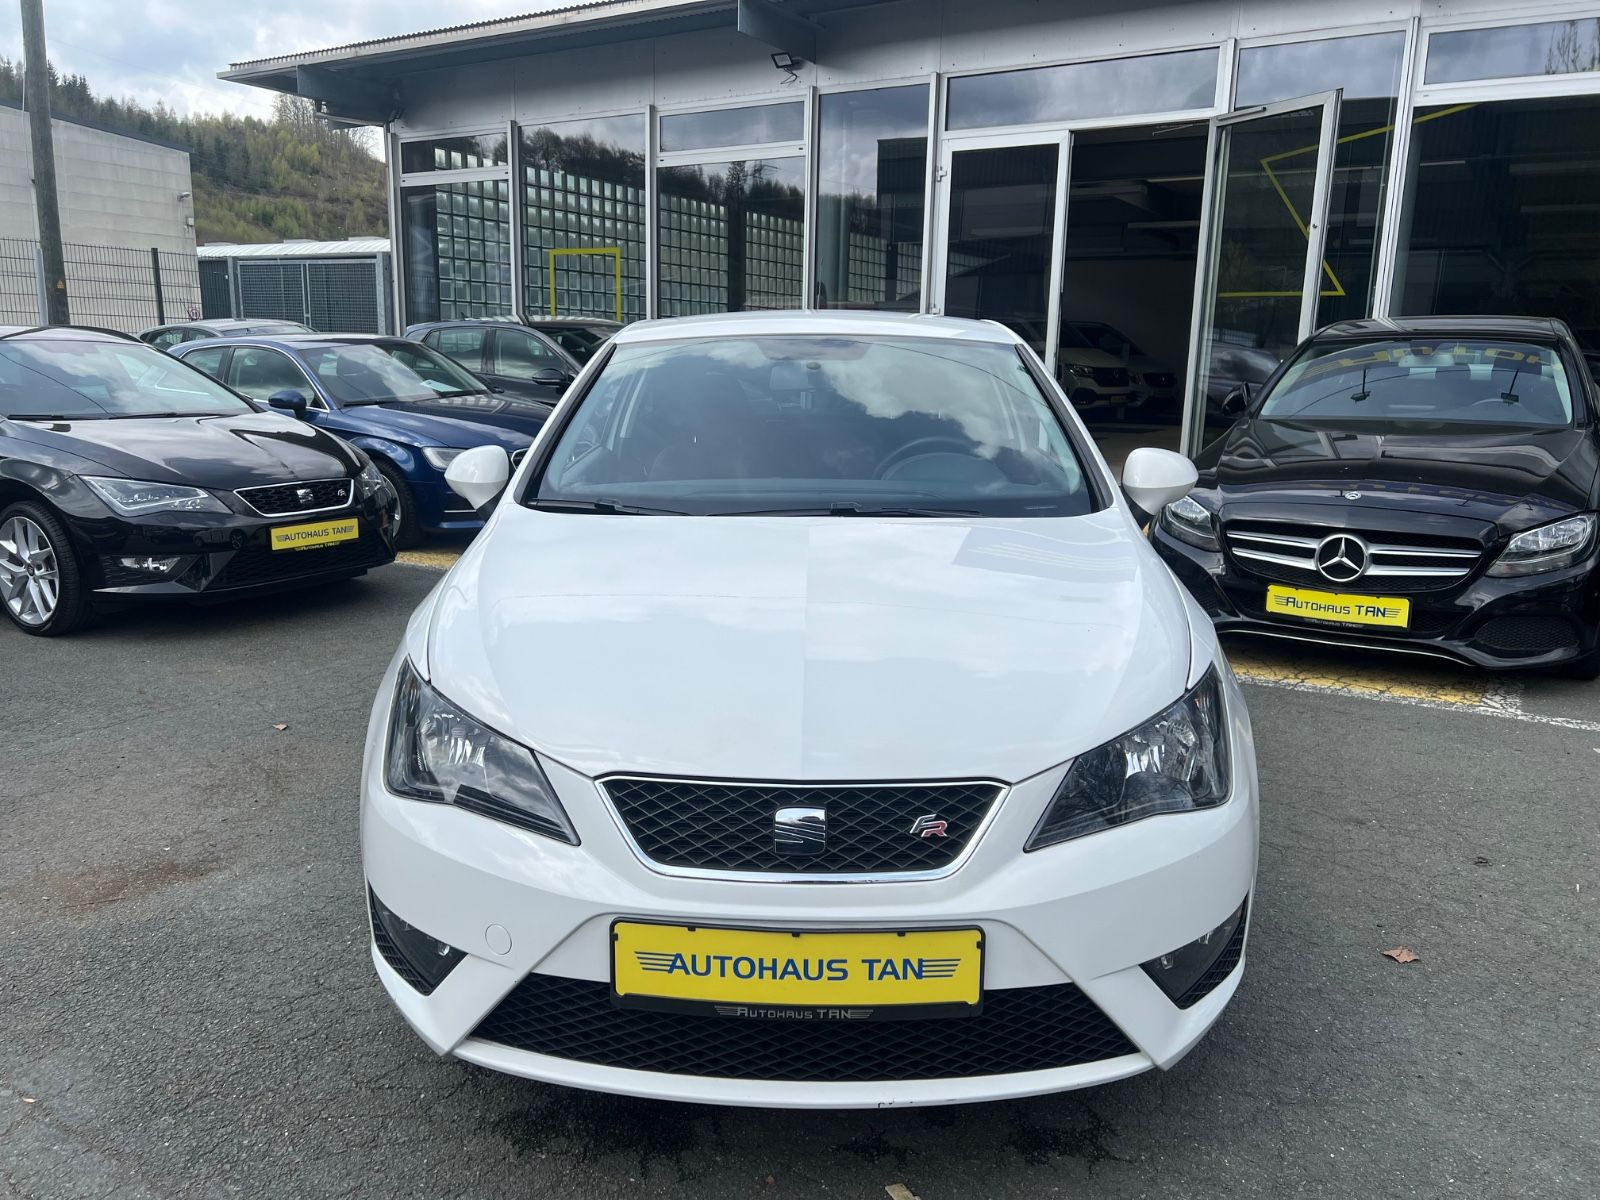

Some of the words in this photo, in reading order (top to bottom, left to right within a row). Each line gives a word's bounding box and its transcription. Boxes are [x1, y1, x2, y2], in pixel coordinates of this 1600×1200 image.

[284, 528, 329, 542] AUTOHAUS
[332, 526, 347, 535] TAN
[1286, 596, 1351, 615] AUTOHAUS
[1355, 604, 1387, 618] TAN
[909, 813, 948, 838] FR
[667, 952, 848, 981] AUTOHAUS
[861, 957, 924, 981] TAN
[737, 1006, 813, 1019] AUTOHAUS
[816, 1009, 851, 1019] TAN
